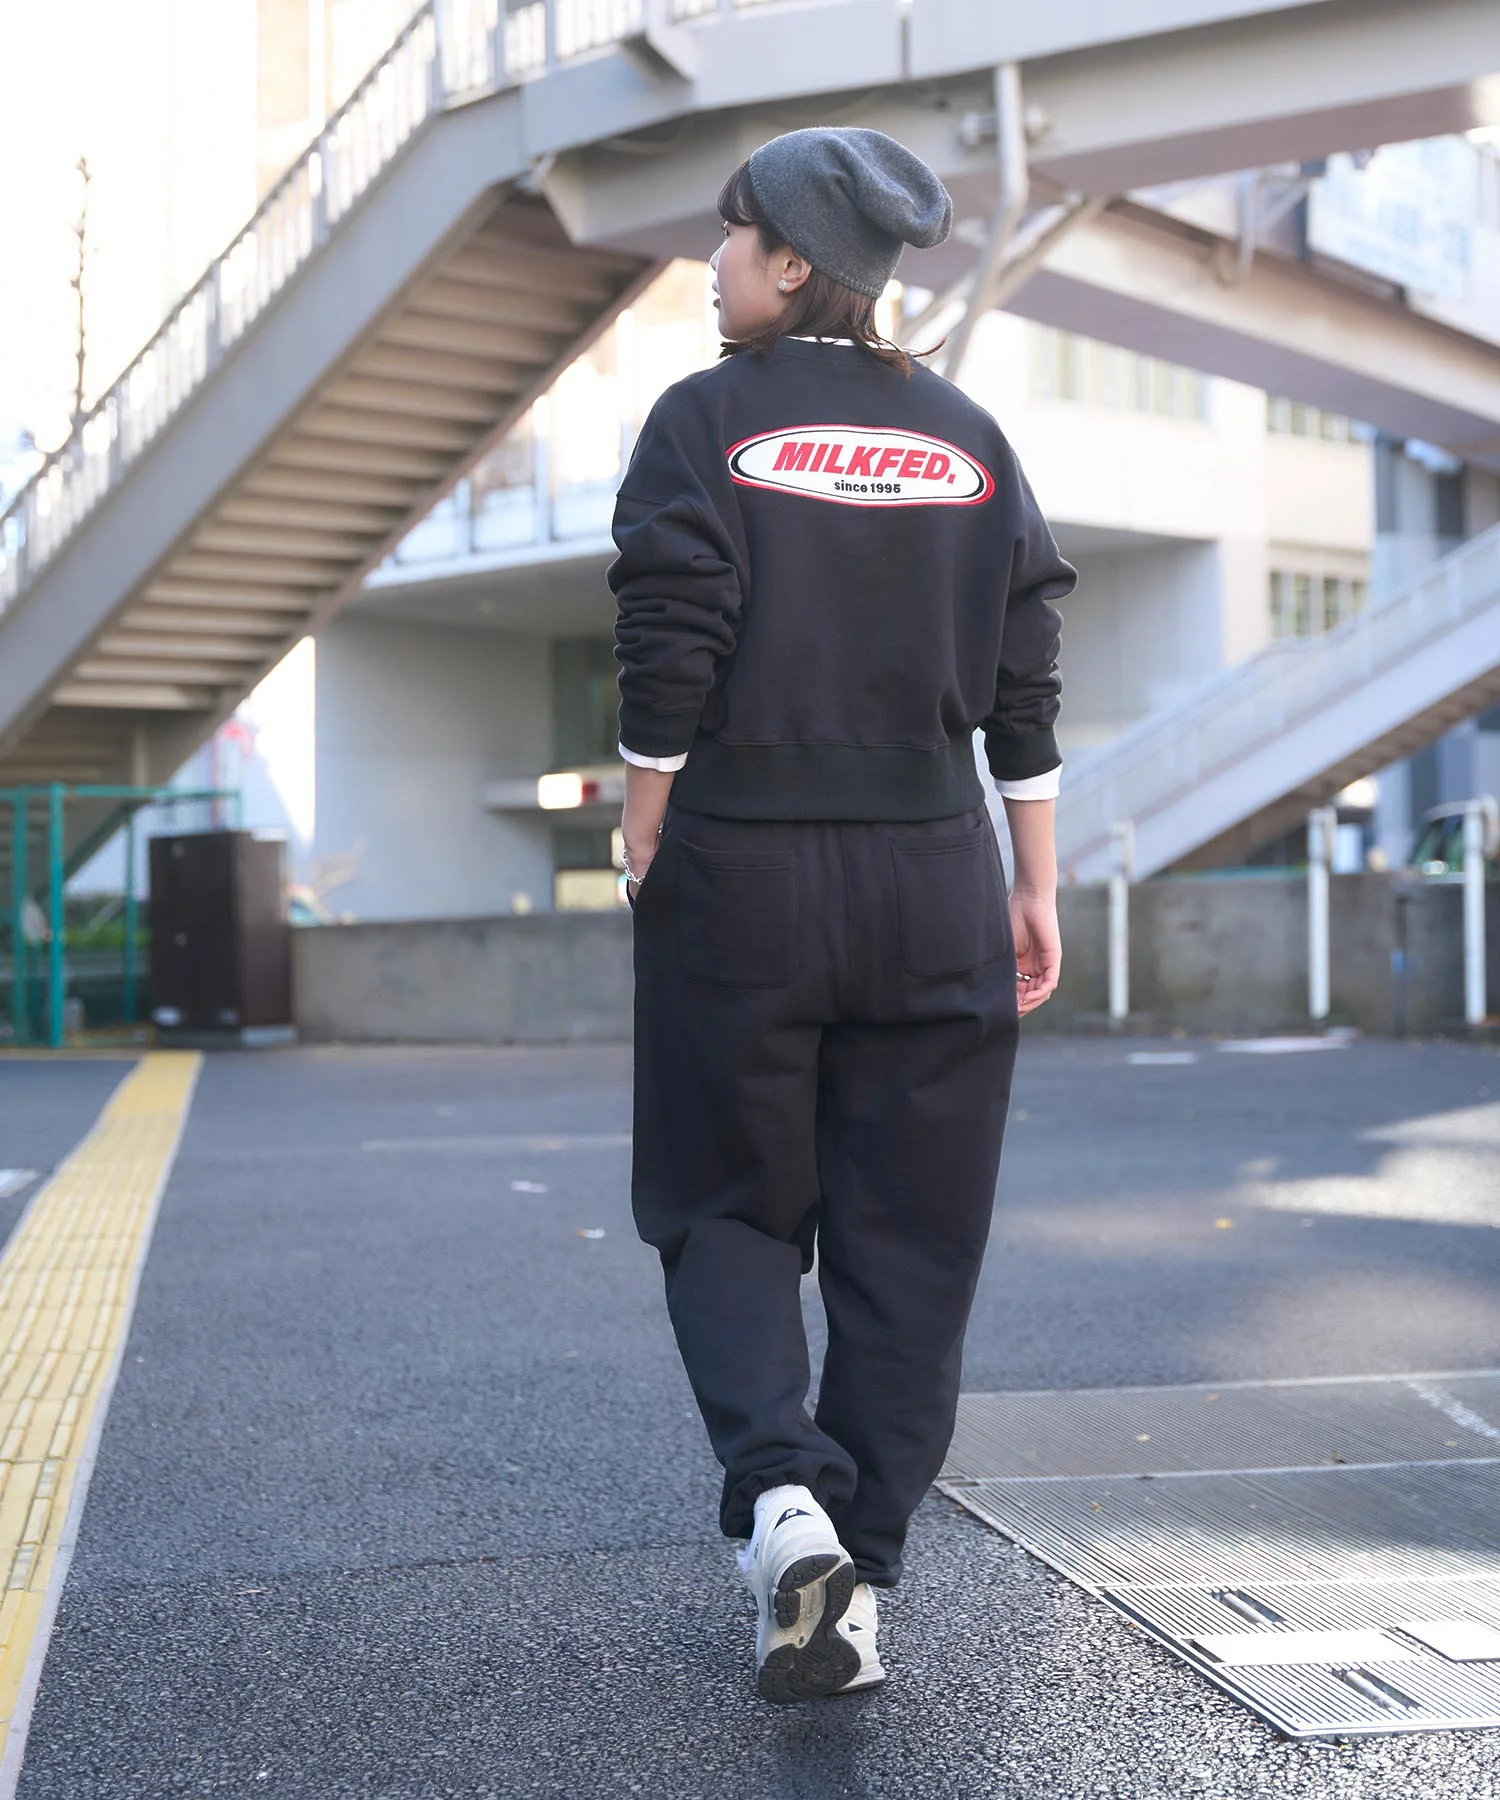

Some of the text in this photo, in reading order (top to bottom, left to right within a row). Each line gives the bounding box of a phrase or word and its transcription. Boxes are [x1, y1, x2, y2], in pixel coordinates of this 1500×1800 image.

[772, 441, 957, 485] MILKFED.
[834, 479, 901, 494] since 1995
